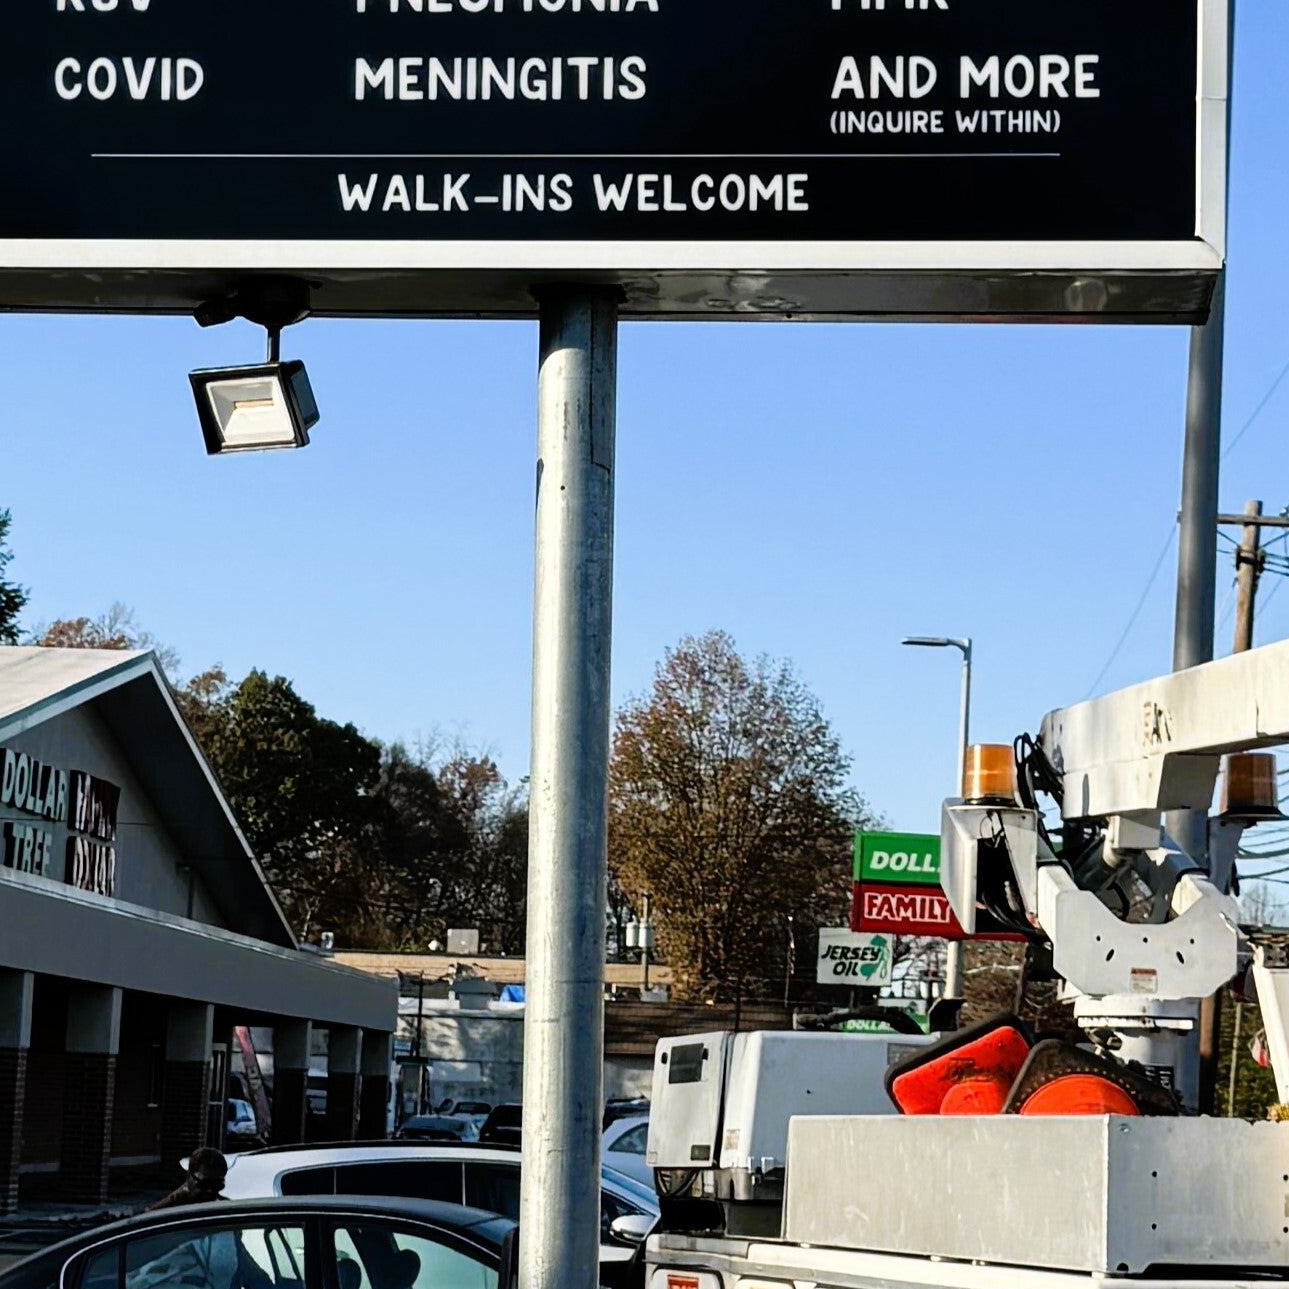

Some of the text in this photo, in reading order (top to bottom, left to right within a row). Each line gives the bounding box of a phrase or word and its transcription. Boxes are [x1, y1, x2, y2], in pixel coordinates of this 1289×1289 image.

[55, 57, 203, 100] COVID
[356, 56, 646, 100] MENINGITIS
[831, 55, 1099, 98] AND MORE
[831, 110, 1060, 133] (INQUIRE WITHIN)
[338, 174, 808, 211] WALK-INS WELCOME
[1, 748, 68, 822] DOLLAR
[12, 823, 53, 876] TREE
[870, 851, 941, 873] DOLL
[864, 892, 951, 924] FAMILY
[821, 944, 881, 961] JERSEY
[833, 962, 859, 977] OIL
